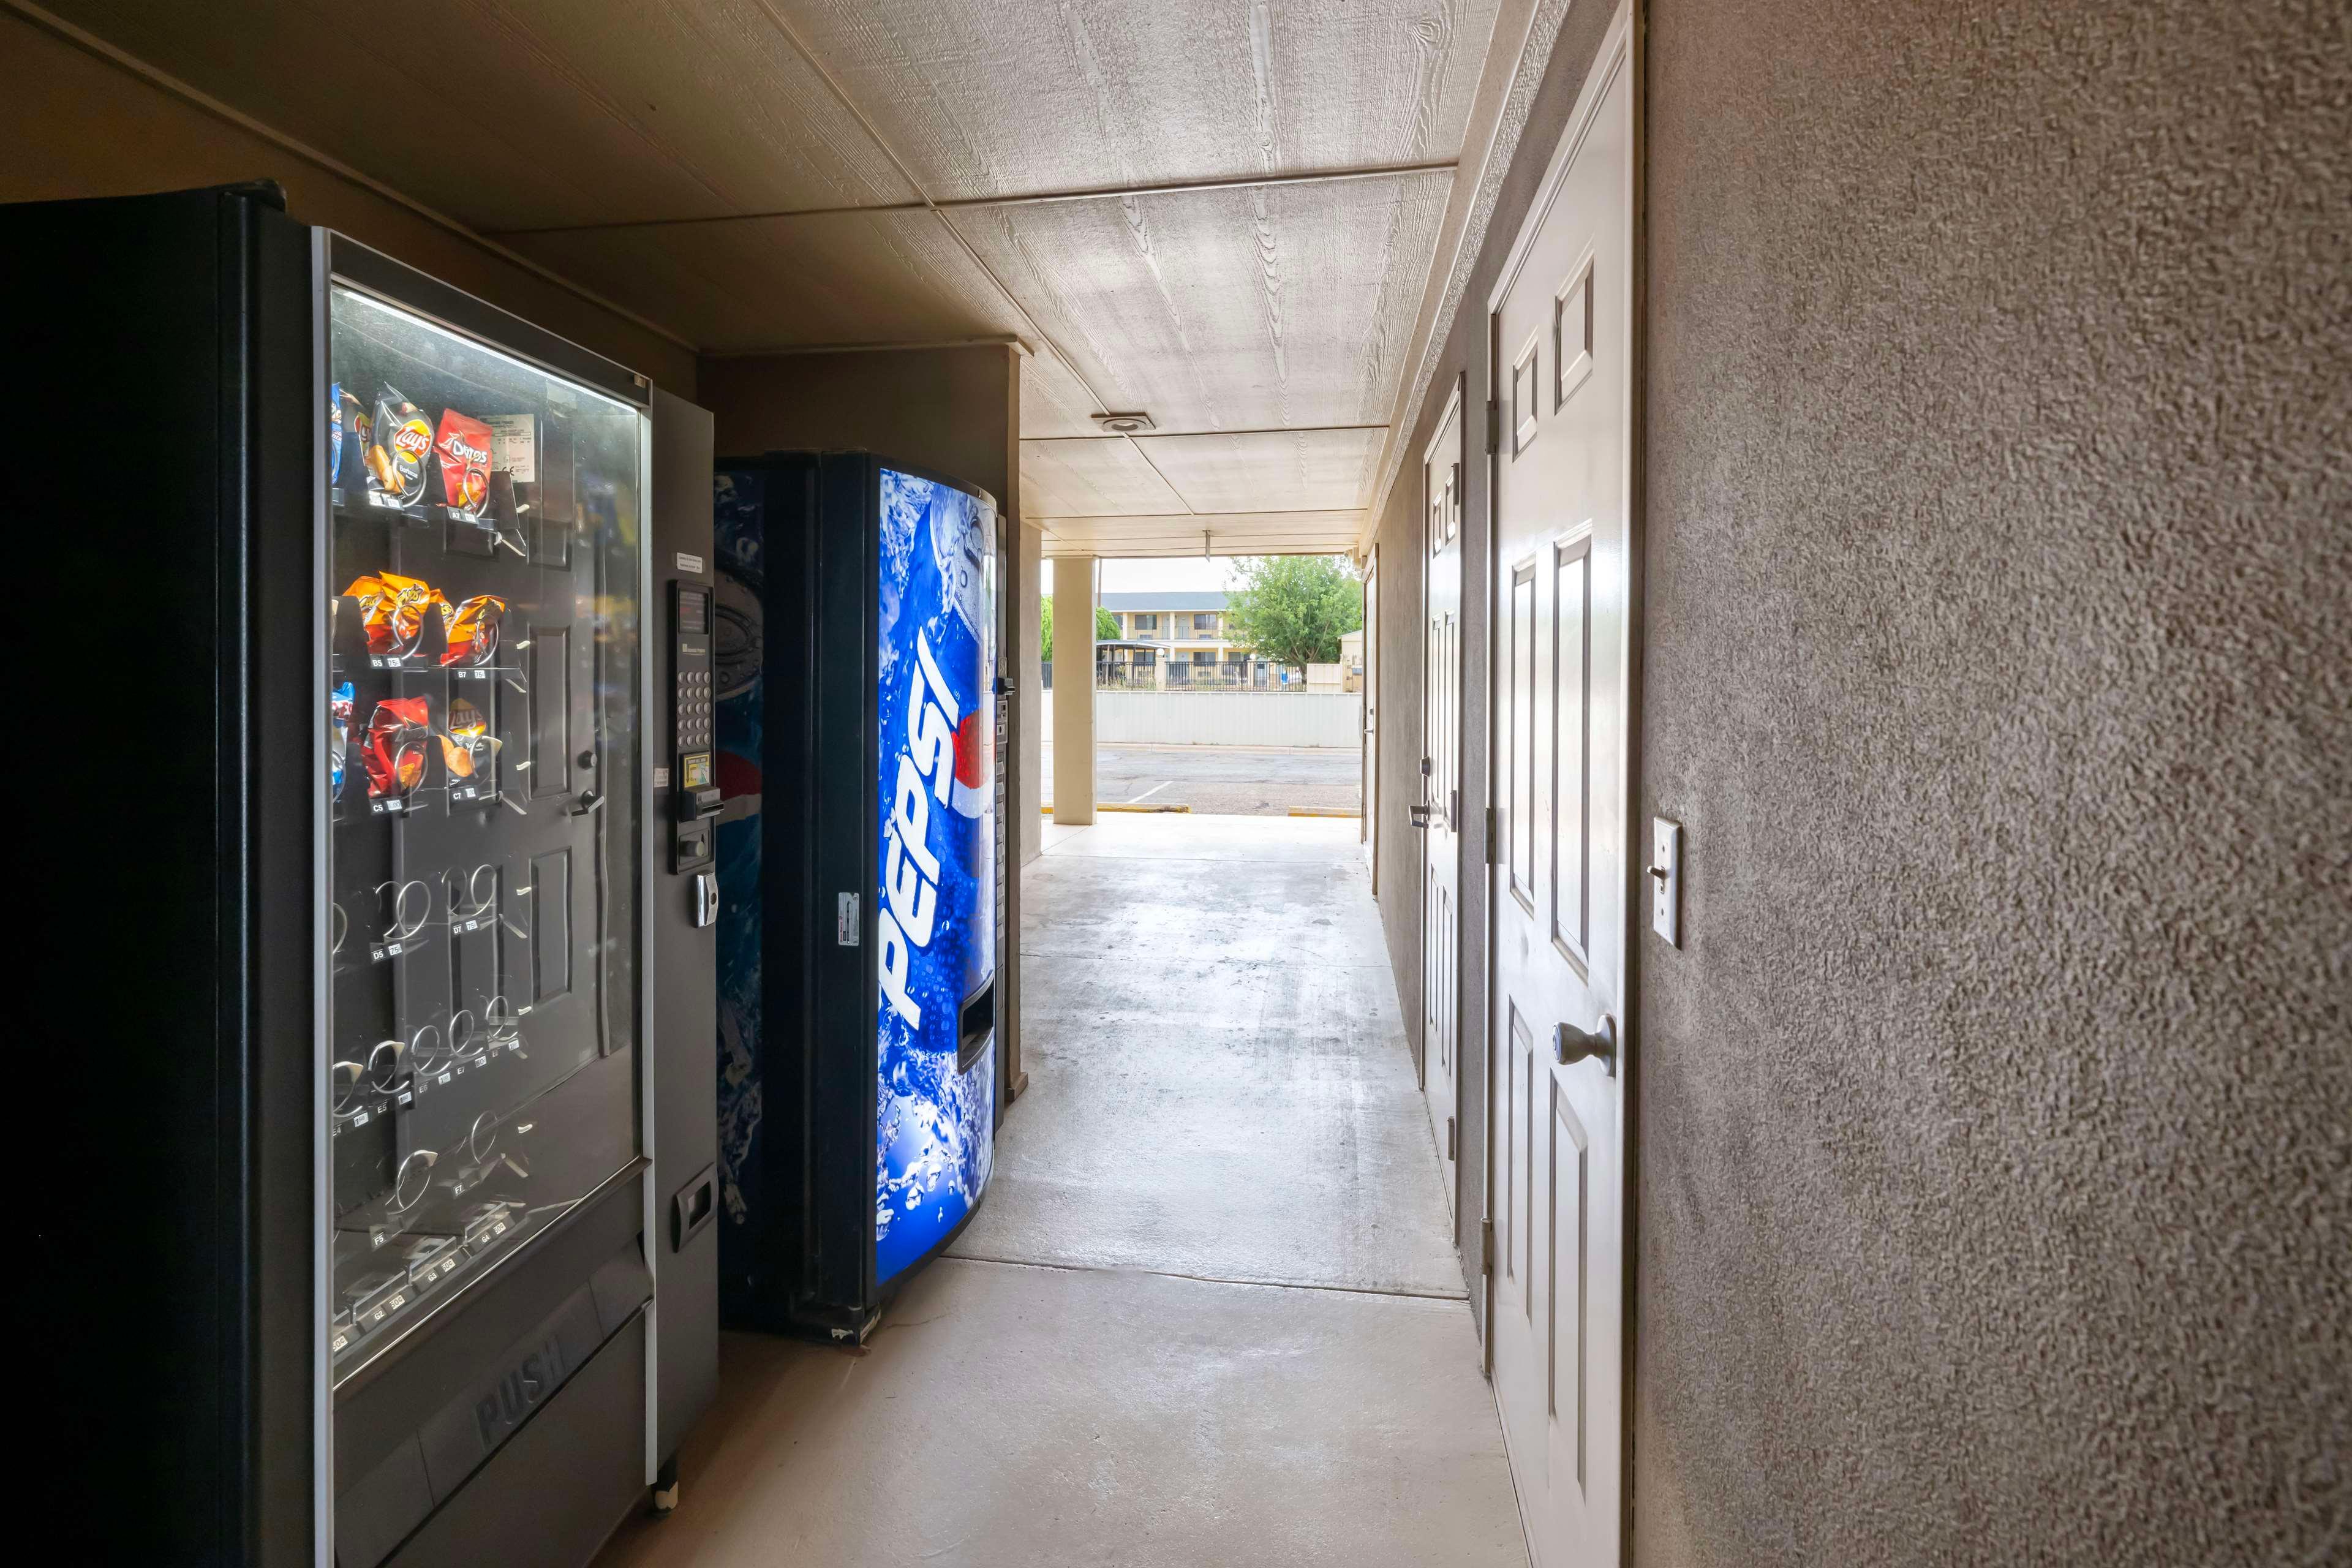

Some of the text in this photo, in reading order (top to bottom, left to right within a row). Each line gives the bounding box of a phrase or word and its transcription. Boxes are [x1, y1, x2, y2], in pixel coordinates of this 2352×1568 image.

[396, 427, 429, 451] Lay's
[878, 625, 960, 1030] PEPSI
[453, 925, 462, 934] D7
[373, 951, 383, 960] D5
[457, 1066, 465, 1075] E7
[419, 1084, 428, 1093] E6
[377, 1104, 387, 1114] E5
[333, 1126, 341, 1137] E4
[454, 1185, 462, 1194] F7
[374, 1235, 384, 1245] F5
[481, 1234, 490, 1243] G4
[428, 1272, 437, 1281] G3
[374, 1296, 404, 1320] G2 50¢
[475, 1334, 568, 1452] PUSH
